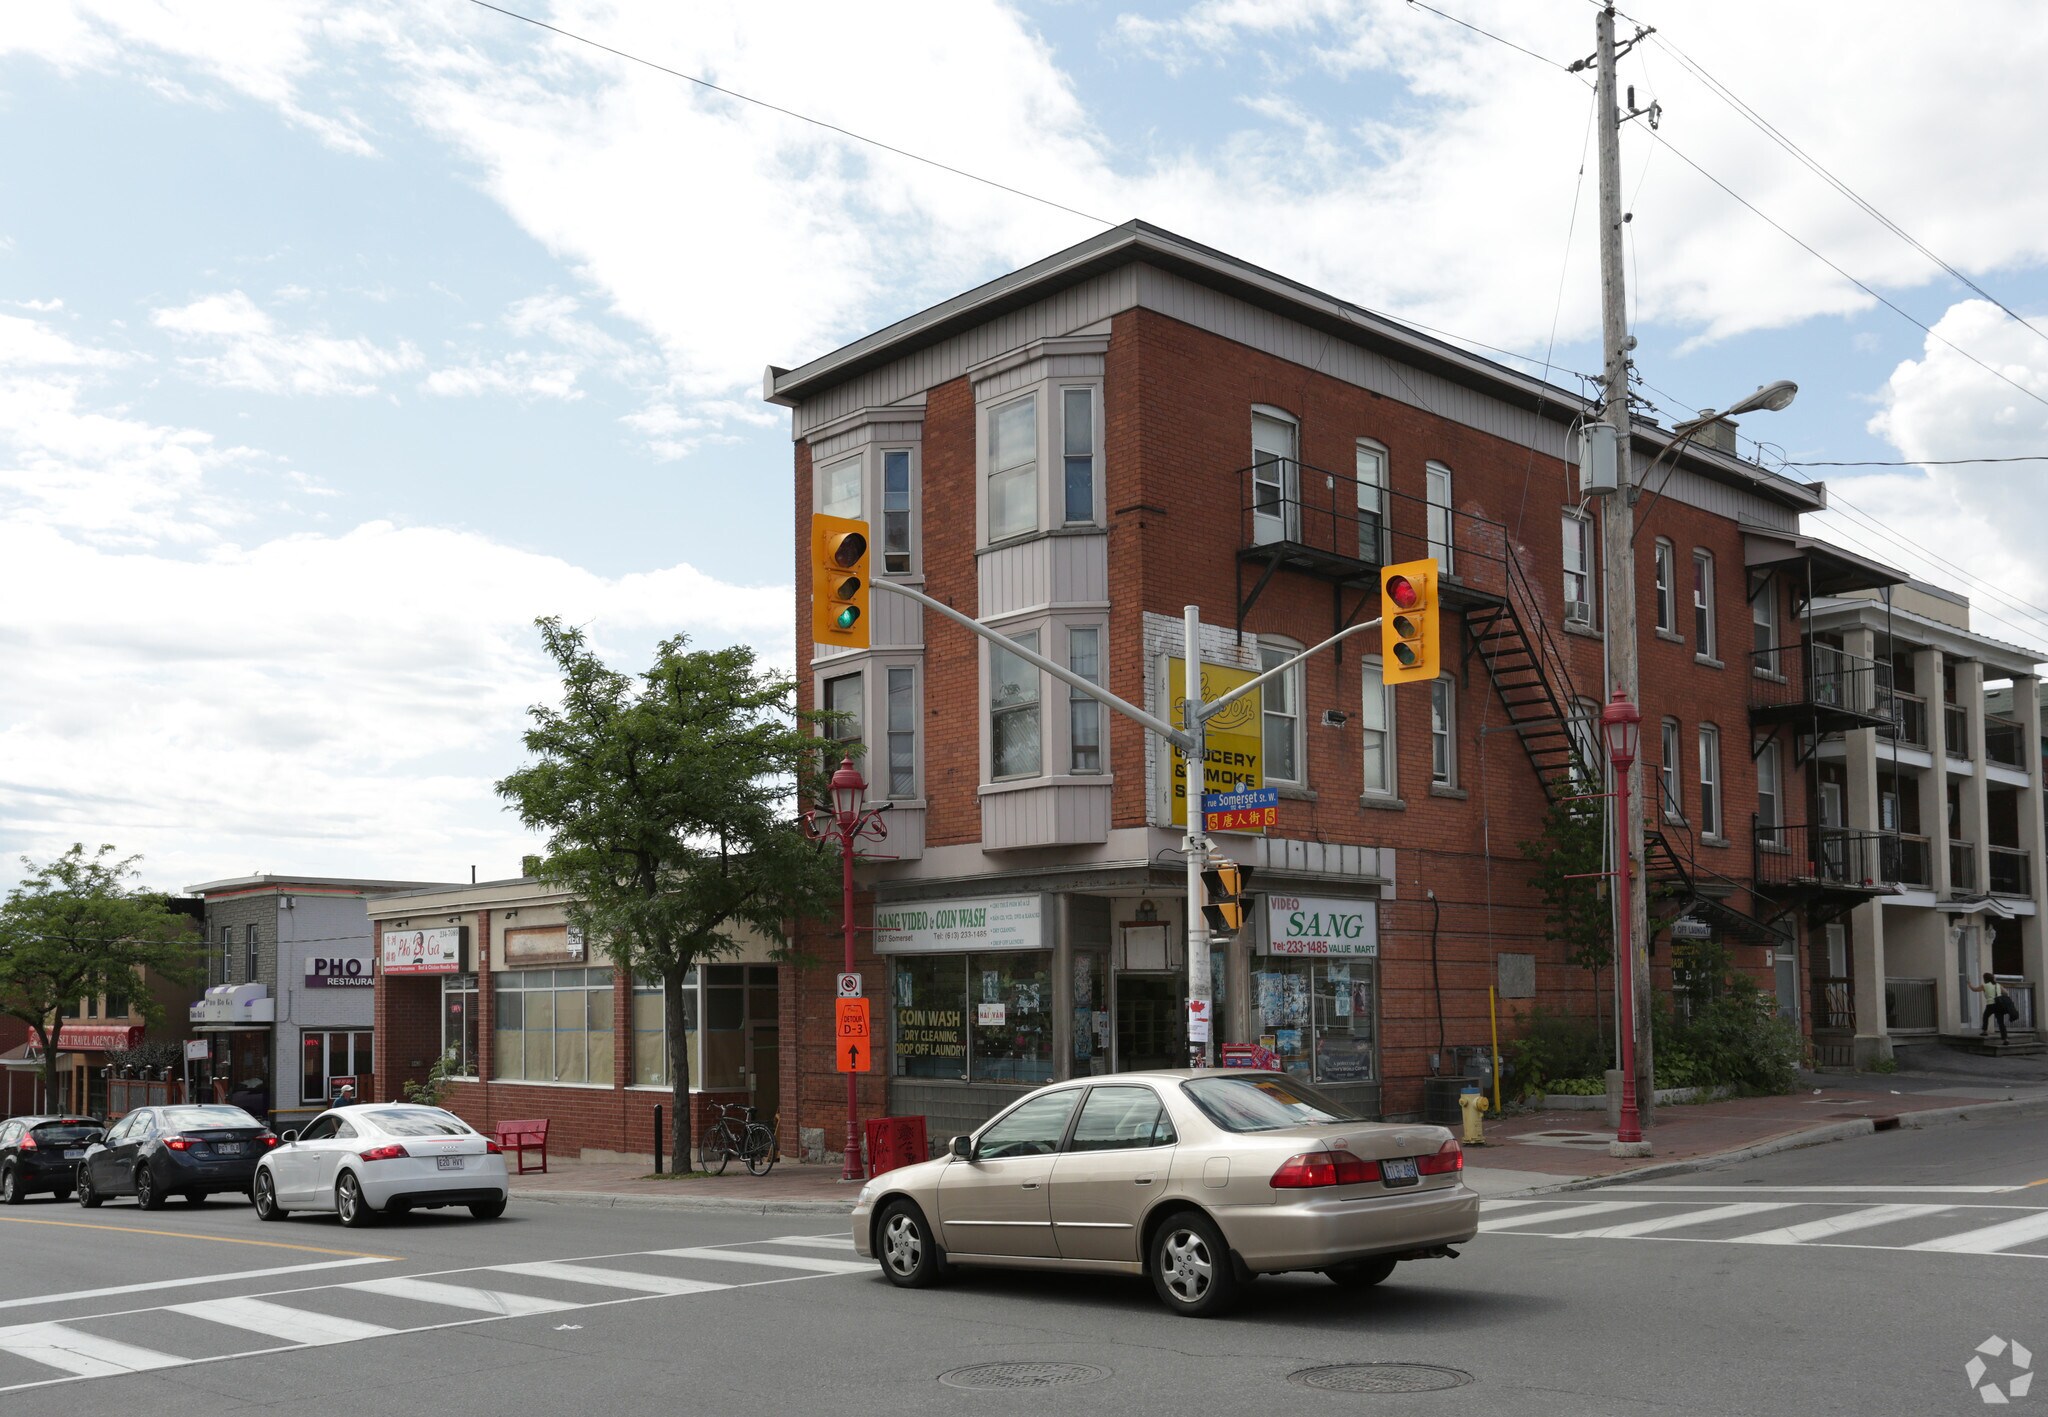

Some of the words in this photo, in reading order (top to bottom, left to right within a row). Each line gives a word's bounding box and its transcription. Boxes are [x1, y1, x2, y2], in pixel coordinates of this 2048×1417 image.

[1174, 746, 1257, 768] GOCERY
[1175, 764, 1186, 778] &
[1218, 791, 1257, 806] Somerset
[1267, 793, 1276, 802] W.
[1222, 811, 1261, 828] 唐人街
[1270, 897, 1300, 910] VIDEO
[900, 911, 928, 931] VIDEO
[935, 909, 957, 930] COIN
[958, 907, 987, 928] WASH
[1286, 911, 1365, 939] SANG
[877, 935, 887, 943] 837
[888, 934, 913, 943] Somerset
[933, 932, 943, 940] Tel:
[960, 930, 987, 939] 233-1485
[1272, 941, 1285, 951] Tel:
[1286, 940, 1328, 954] 233-1485
[1328, 945, 1351, 953] VALUE
[1354, 945, 1376, 953] MART
[314, 958, 362, 977] PHO
[843, 1015, 863, 1023] DETOUR
[900, 1010, 925, 1026] COIN
[928, 1010, 961, 1027] WASH
[844, 1024, 863, 1034] D-3
[904, 1029, 919, 1041] DRY
[920, 1031, 958, 1043] CLEANING
[70, 1034, 91, 1046] TRAVEL
[895, 1043, 914, 1054] DROP
[914, 1044, 929, 1055] OFF
[930, 1045, 966, 1056] LAUNDRY
